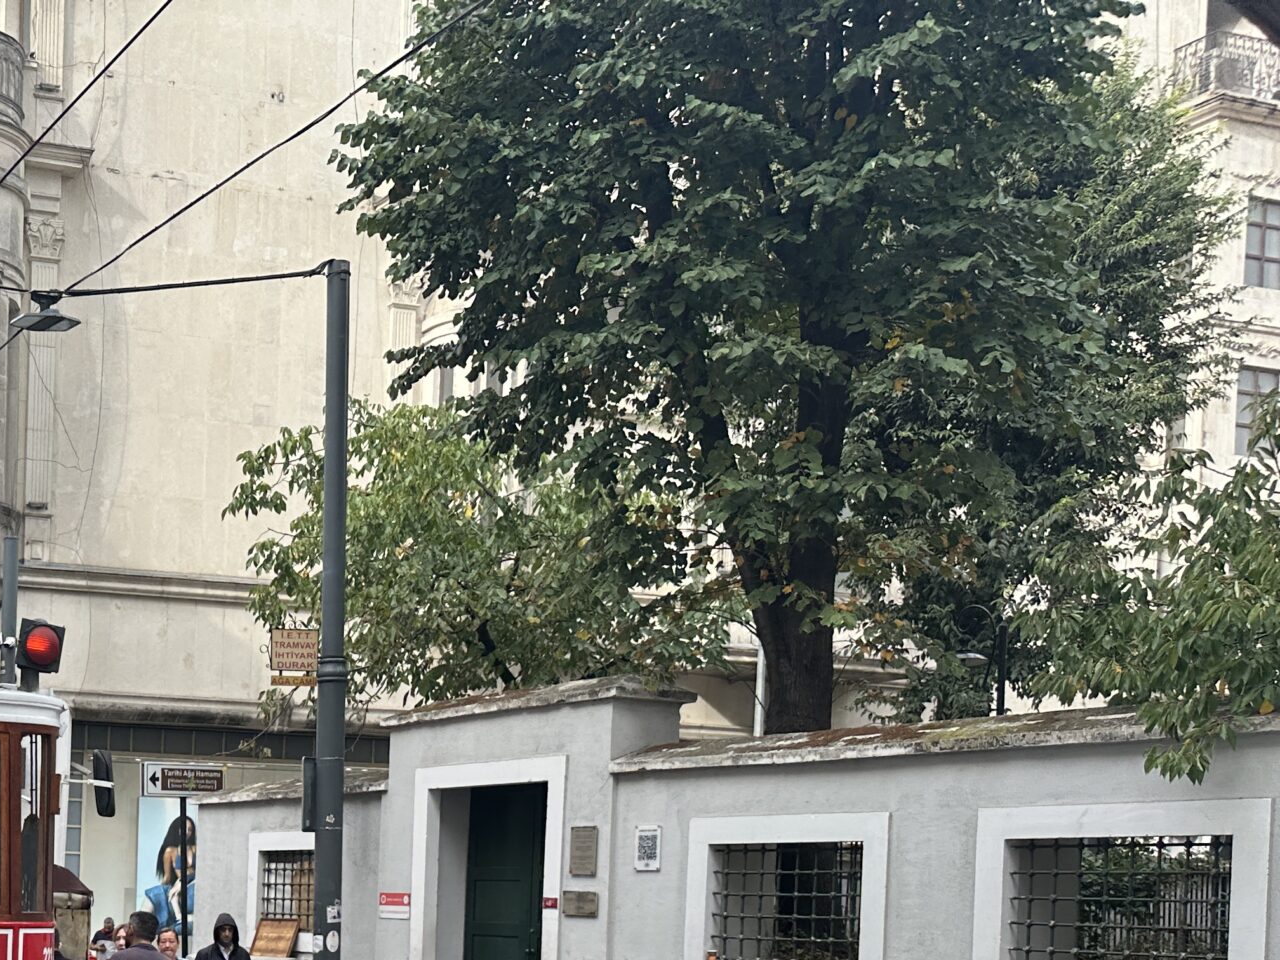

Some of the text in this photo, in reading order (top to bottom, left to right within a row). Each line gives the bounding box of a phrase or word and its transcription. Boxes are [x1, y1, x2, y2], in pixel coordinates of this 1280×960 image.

[274, 641, 316, 650] TRAMVAY
[277, 661, 314, 669] DURAK
[164, 769, 182, 777] Tarihi
